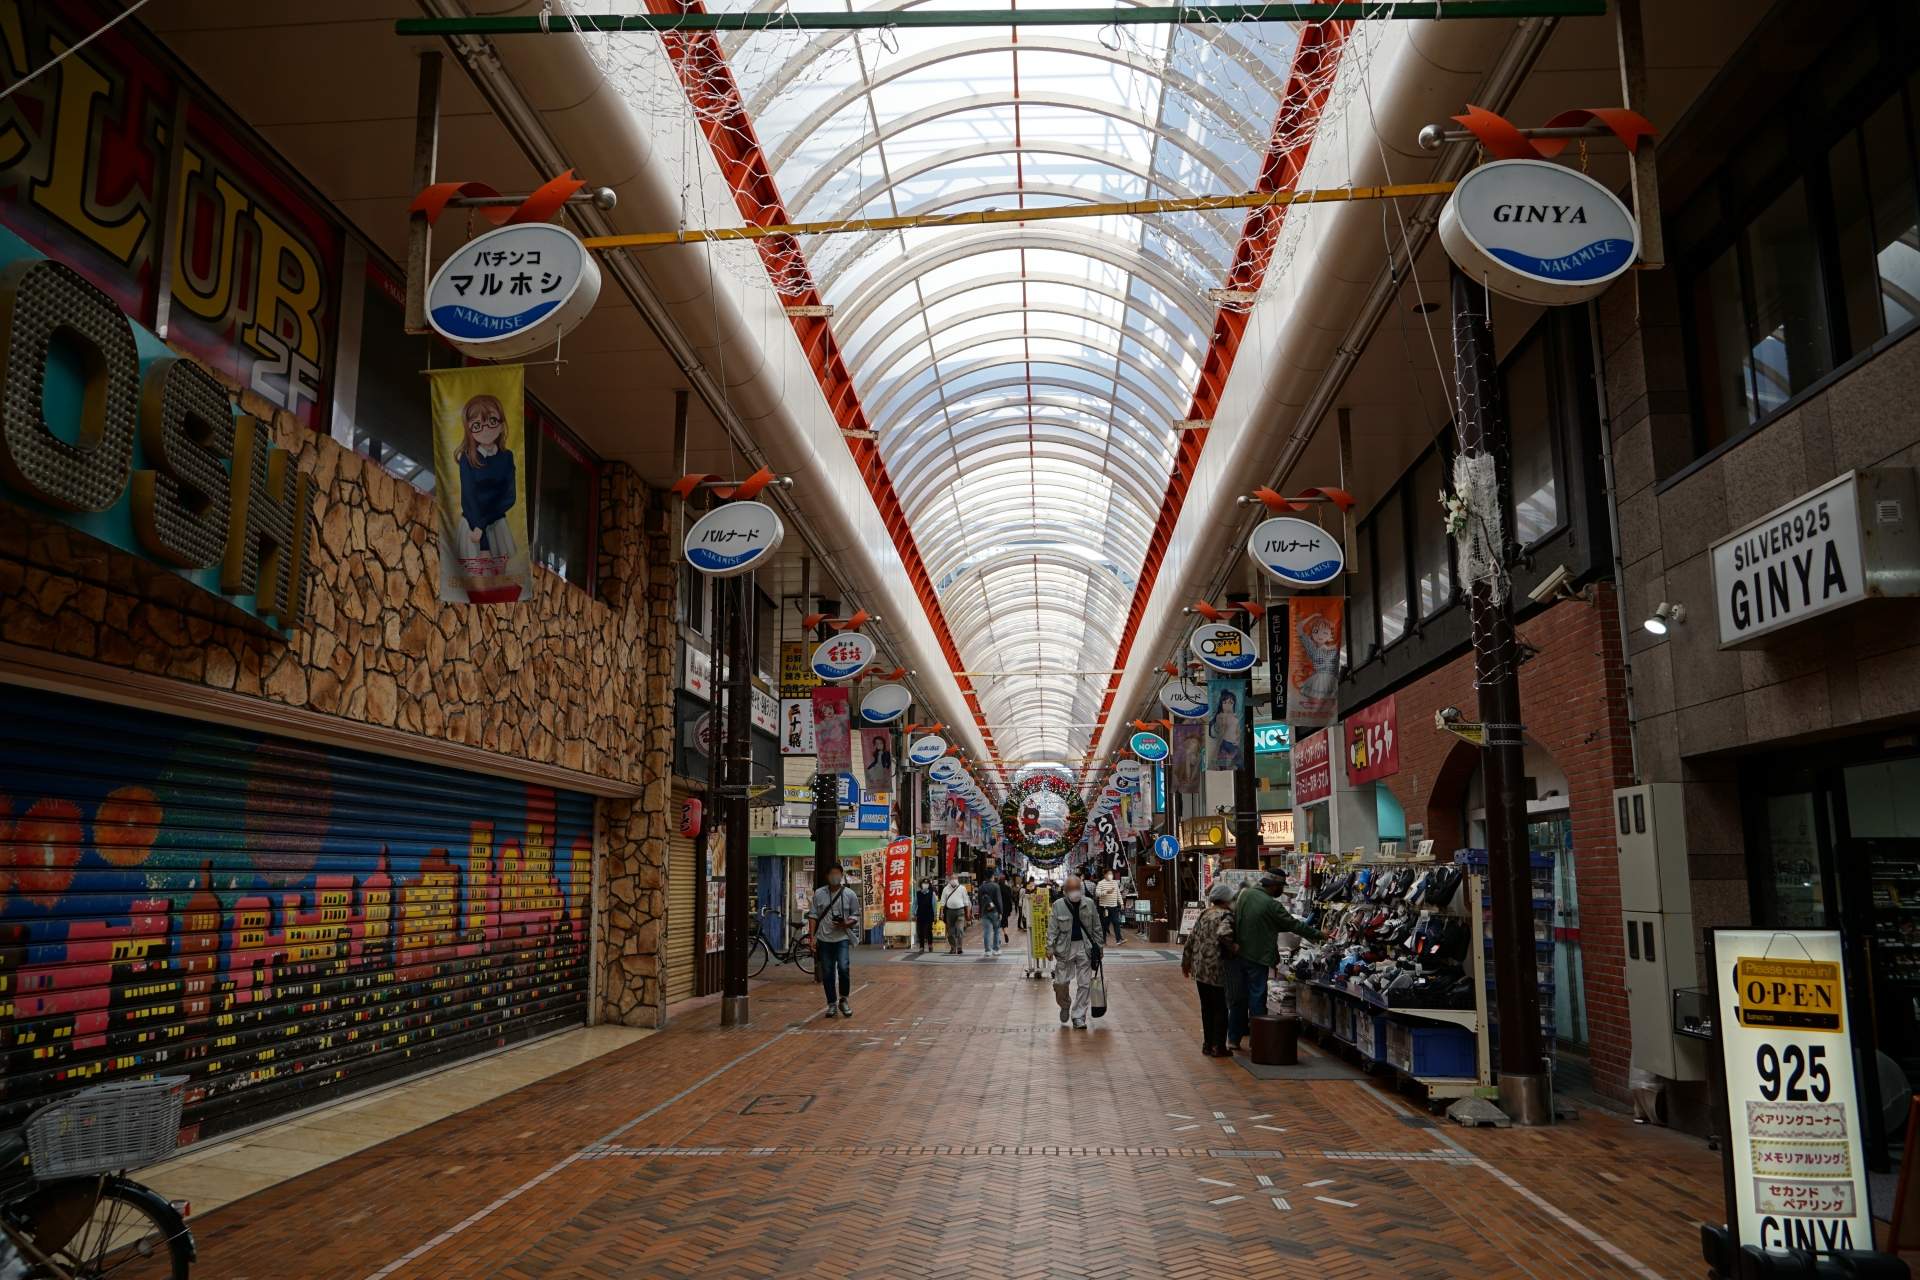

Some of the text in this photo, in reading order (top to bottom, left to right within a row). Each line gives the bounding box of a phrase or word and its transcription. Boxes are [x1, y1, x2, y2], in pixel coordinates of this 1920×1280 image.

[1493, 204, 1588, 224] GINYA
[474, 251, 541, 267] パチンコ
[1540, 239, 1616, 273] NAKAMISE
[450, 272, 562, 296] マルホシ
[453, 306, 525, 330] NAKAMISE
[250, 327, 322, 412] 2F
[701, 529, 760, 543] バルナード
[1734, 502, 1830, 571] SILVER925
[1264, 540, 1320, 553] バルナード
[700, 549, 742, 565] NAKAMISE
[1293, 561, 1333, 579] NAKAMISE
[1731, 539, 1848, 630] GINYA
[1272, 614, 1282, 653] 生ビール
[782, 644, 793, 652] 3F
[1223, 639, 1238, 648] トラヤ
[827, 646, 863, 661] 香香坊
[1221, 655, 1250, 668] NAKAMISE
[822, 664, 850, 676] NAKAMISE
[1274, 661, 1284, 704] 199円
[1170, 693, 1202, 702] バルナード
[1138, 743, 1161, 751] NOVA
[1366, 720, 1393, 767] トラヤ
[681, 803, 692, 832] ラーメン
[860, 813, 888, 824] NUMBERS
[889, 859, 906, 918] 発売中
[1745, 962, 1832, 978] Please come in!
[1756, 1043, 1831, 1103] 925
[1754, 1114, 1841, 1126] ペアリングコーナー
[1768, 1185, 1820, 1198] セカンド
[1783, 1198, 1844, 1212] ペアリング
[1760, 1215, 1855, 1252] GINYA
